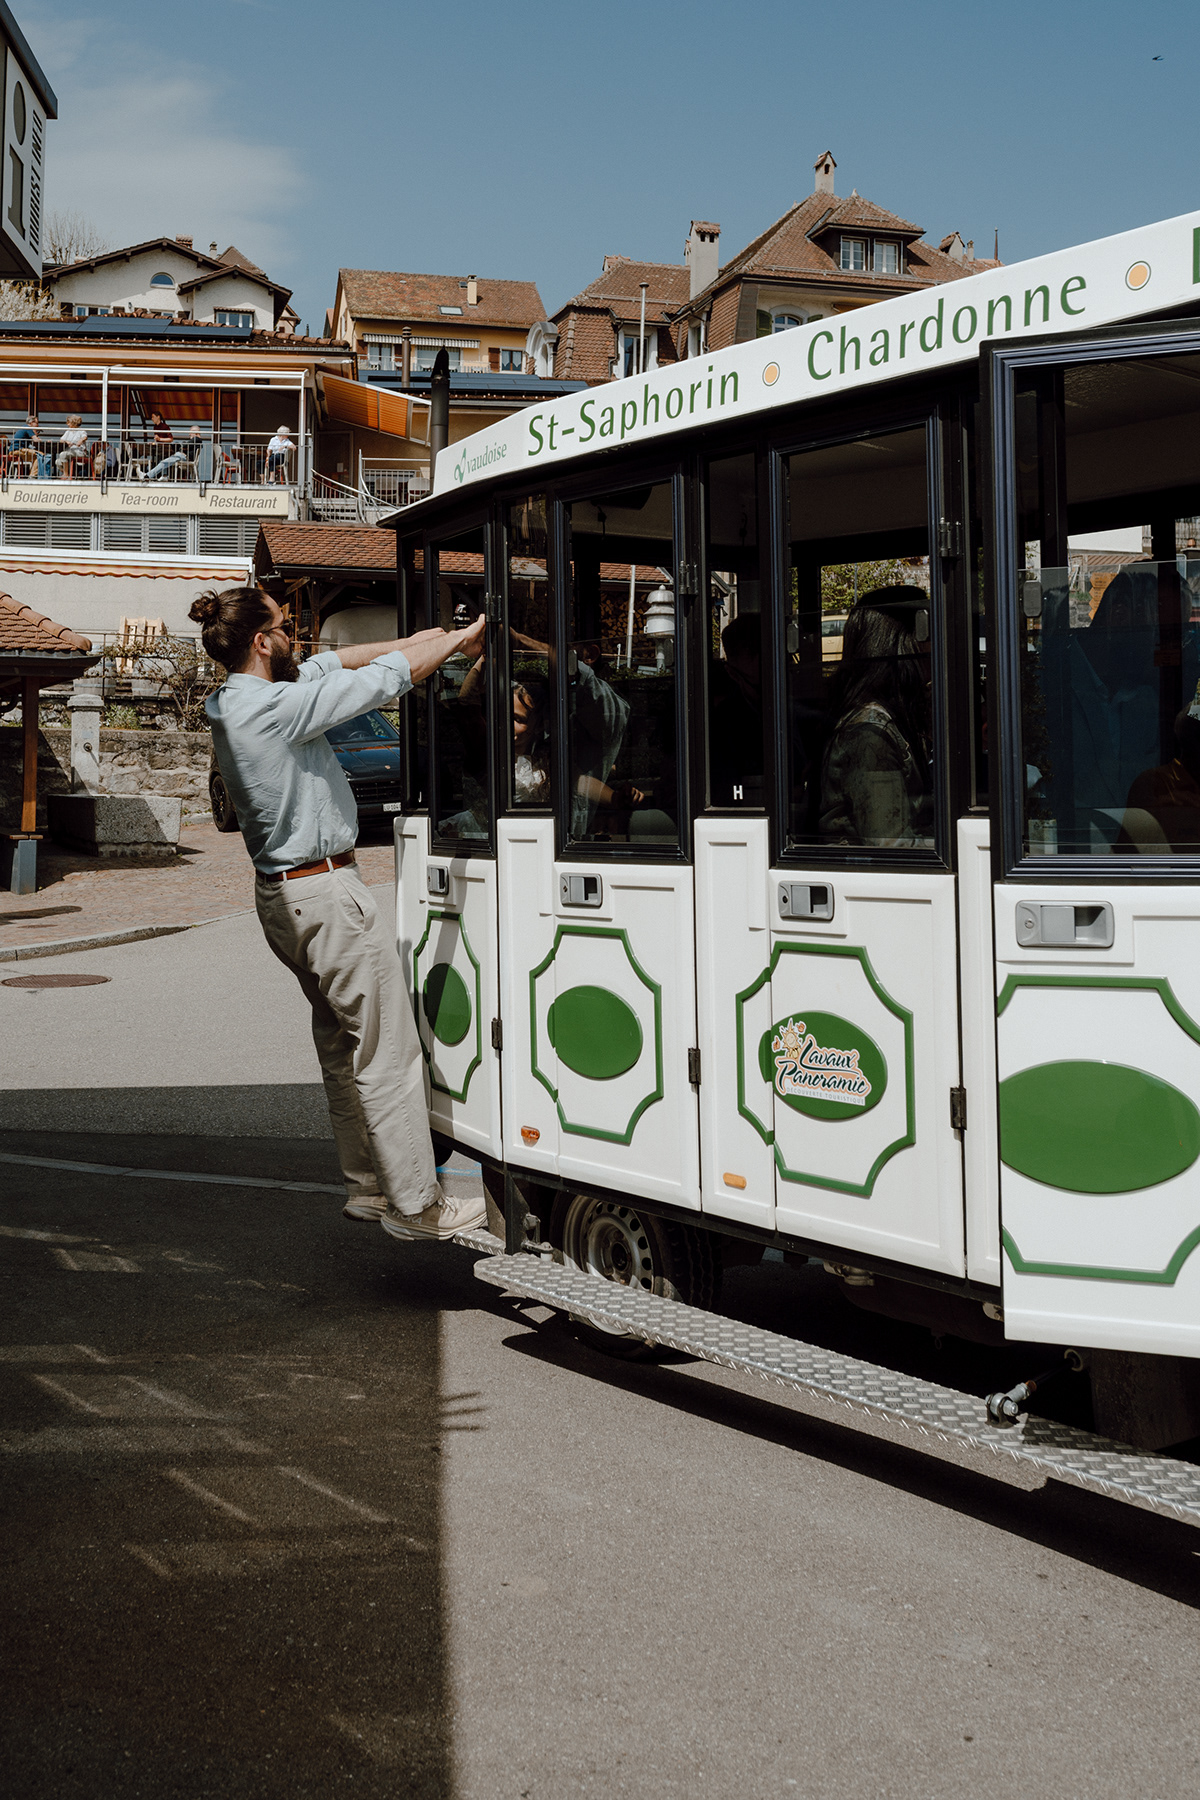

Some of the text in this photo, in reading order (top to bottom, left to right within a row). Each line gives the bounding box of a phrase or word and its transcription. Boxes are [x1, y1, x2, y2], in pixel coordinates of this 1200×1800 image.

[29, 109, 43, 256] TOURIST INFO
[807, 275, 1087, 380] Chardonne
[527, 365, 739, 456] St-Saphorin
[466, 441, 508, 475] vaudoise
[13, 490, 89, 506] Boulangerie
[120, 492, 179, 507] Tea-room
[209, 494, 278, 509] Restaurant
[733, 785, 743, 800] H
[800, 1039, 859, 1075] Lavaux
[778, 1060, 868, 1094] Panoramic
[825, 1092, 865, 1105] TOURISTIQUE
